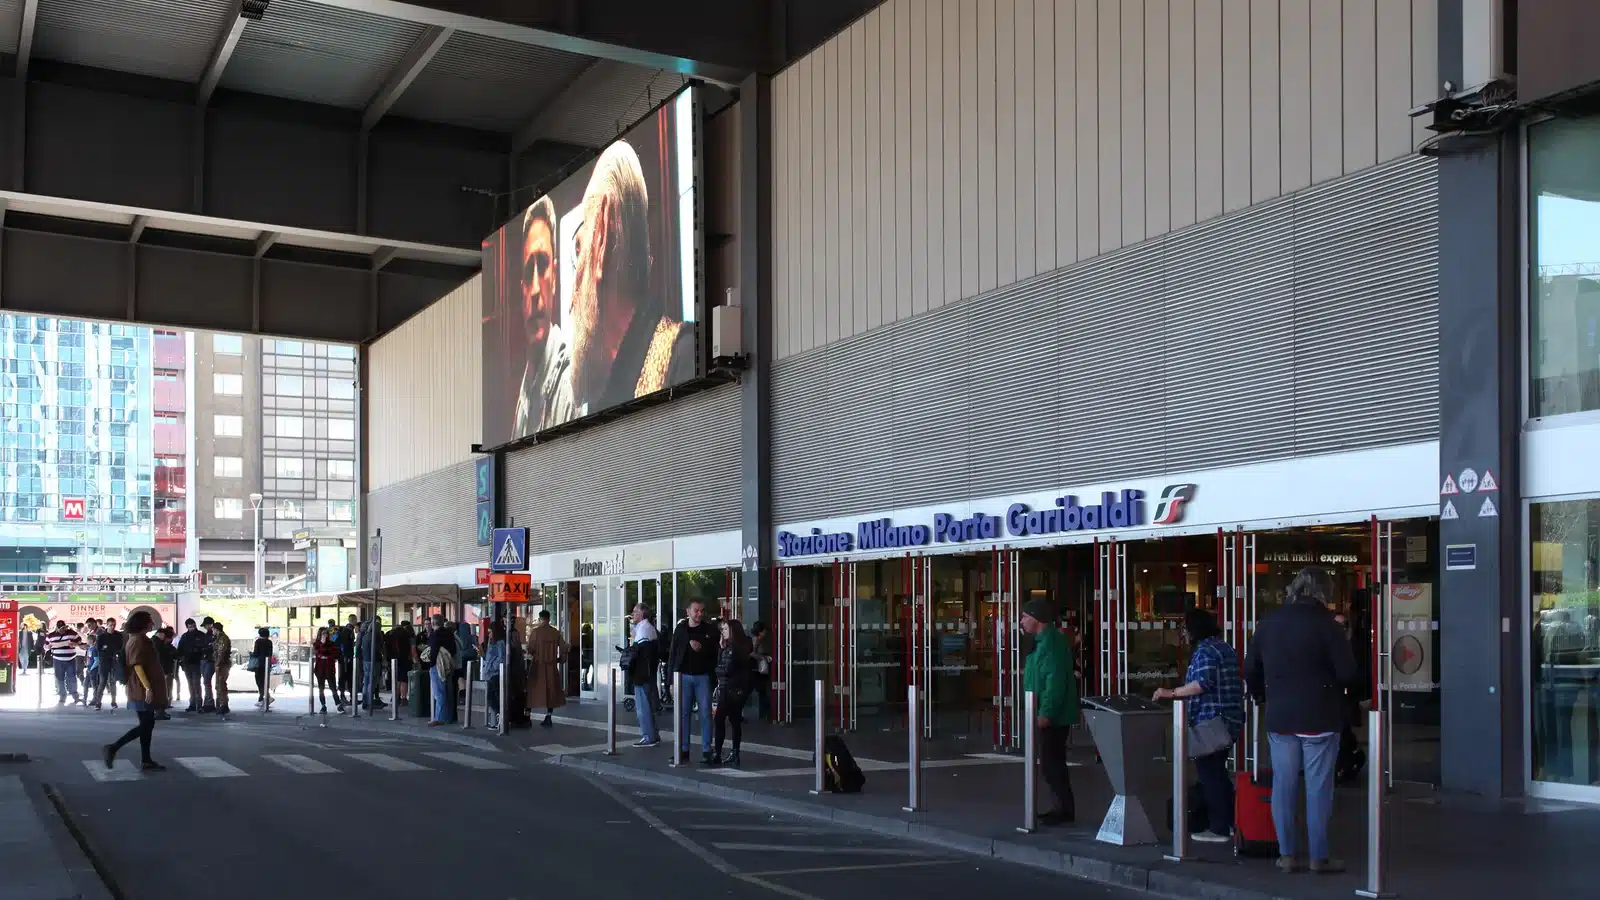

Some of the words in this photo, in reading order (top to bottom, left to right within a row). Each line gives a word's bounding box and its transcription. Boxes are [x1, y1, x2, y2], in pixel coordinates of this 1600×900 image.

[65, 503, 83, 516] M
[777, 528, 852, 557] Stazione
[857, 518, 931, 550] Milano
[934, 513, 1002, 543] Porta
[1006, 488, 1145, 537] Garibaldi
[1320, 554, 1358, 564] express
[494, 582, 526, 593] TAXI
[70, 604, 106, 612] DINNER
